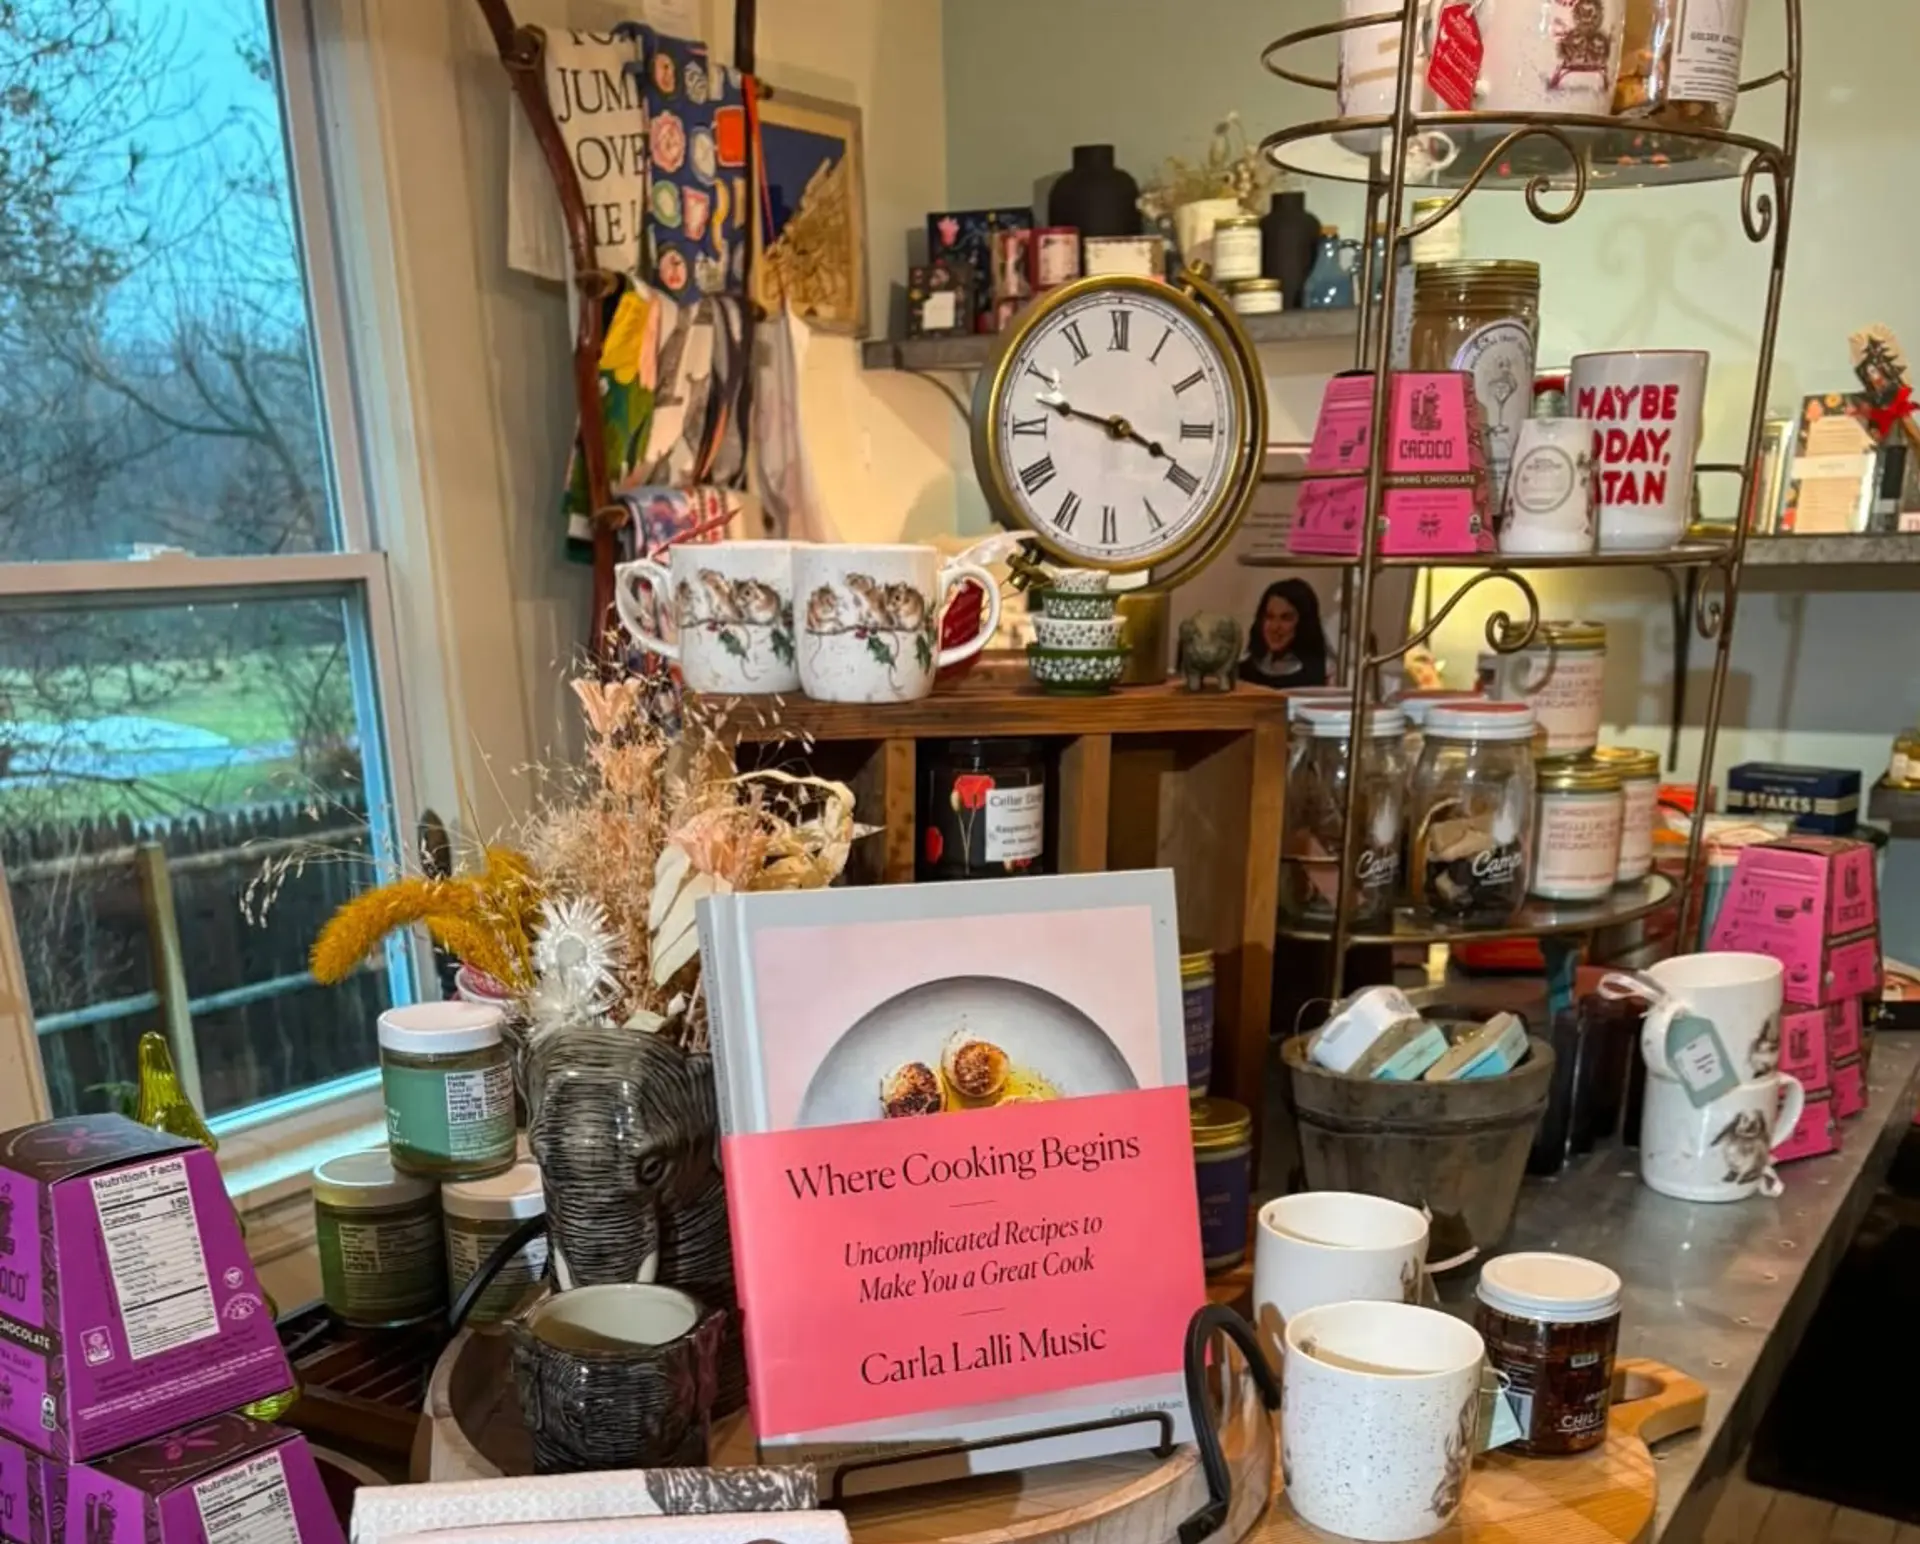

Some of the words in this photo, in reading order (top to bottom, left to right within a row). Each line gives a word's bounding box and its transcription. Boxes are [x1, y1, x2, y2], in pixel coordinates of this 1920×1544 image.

[1576, 384, 1679, 421] MAYBE
[1594, 470, 1667, 505] TAN
[94, 1170, 148, 1191] Nutrition
[149, 1161, 183, 1176] Facts
[785, 1162, 896, 1200] Where
[902, 1145, 1037, 1186] Cooking
[1041, 1131, 1141, 1172] Begins
[844, 1221, 1000, 1267] Uncomplicated
[1005, 1217, 1079, 1247] Recipes
[1083, 1216, 1103, 1235] to
[859, 1272, 916, 1304] Make
[922, 1268, 958, 1294] You
[963, 1270, 976, 1289] a
[981, 1260, 1039, 1286] Great
[1043, 1246, 1094, 1277] Cook
[860, 1345, 946, 1386] Carla
[952, 1334, 1012, 1372] Lalli
[1019, 1323, 1107, 1362] Music
[197, 1470, 247, 1495] Nutrition
[247, 1456, 278, 1475] Facts
